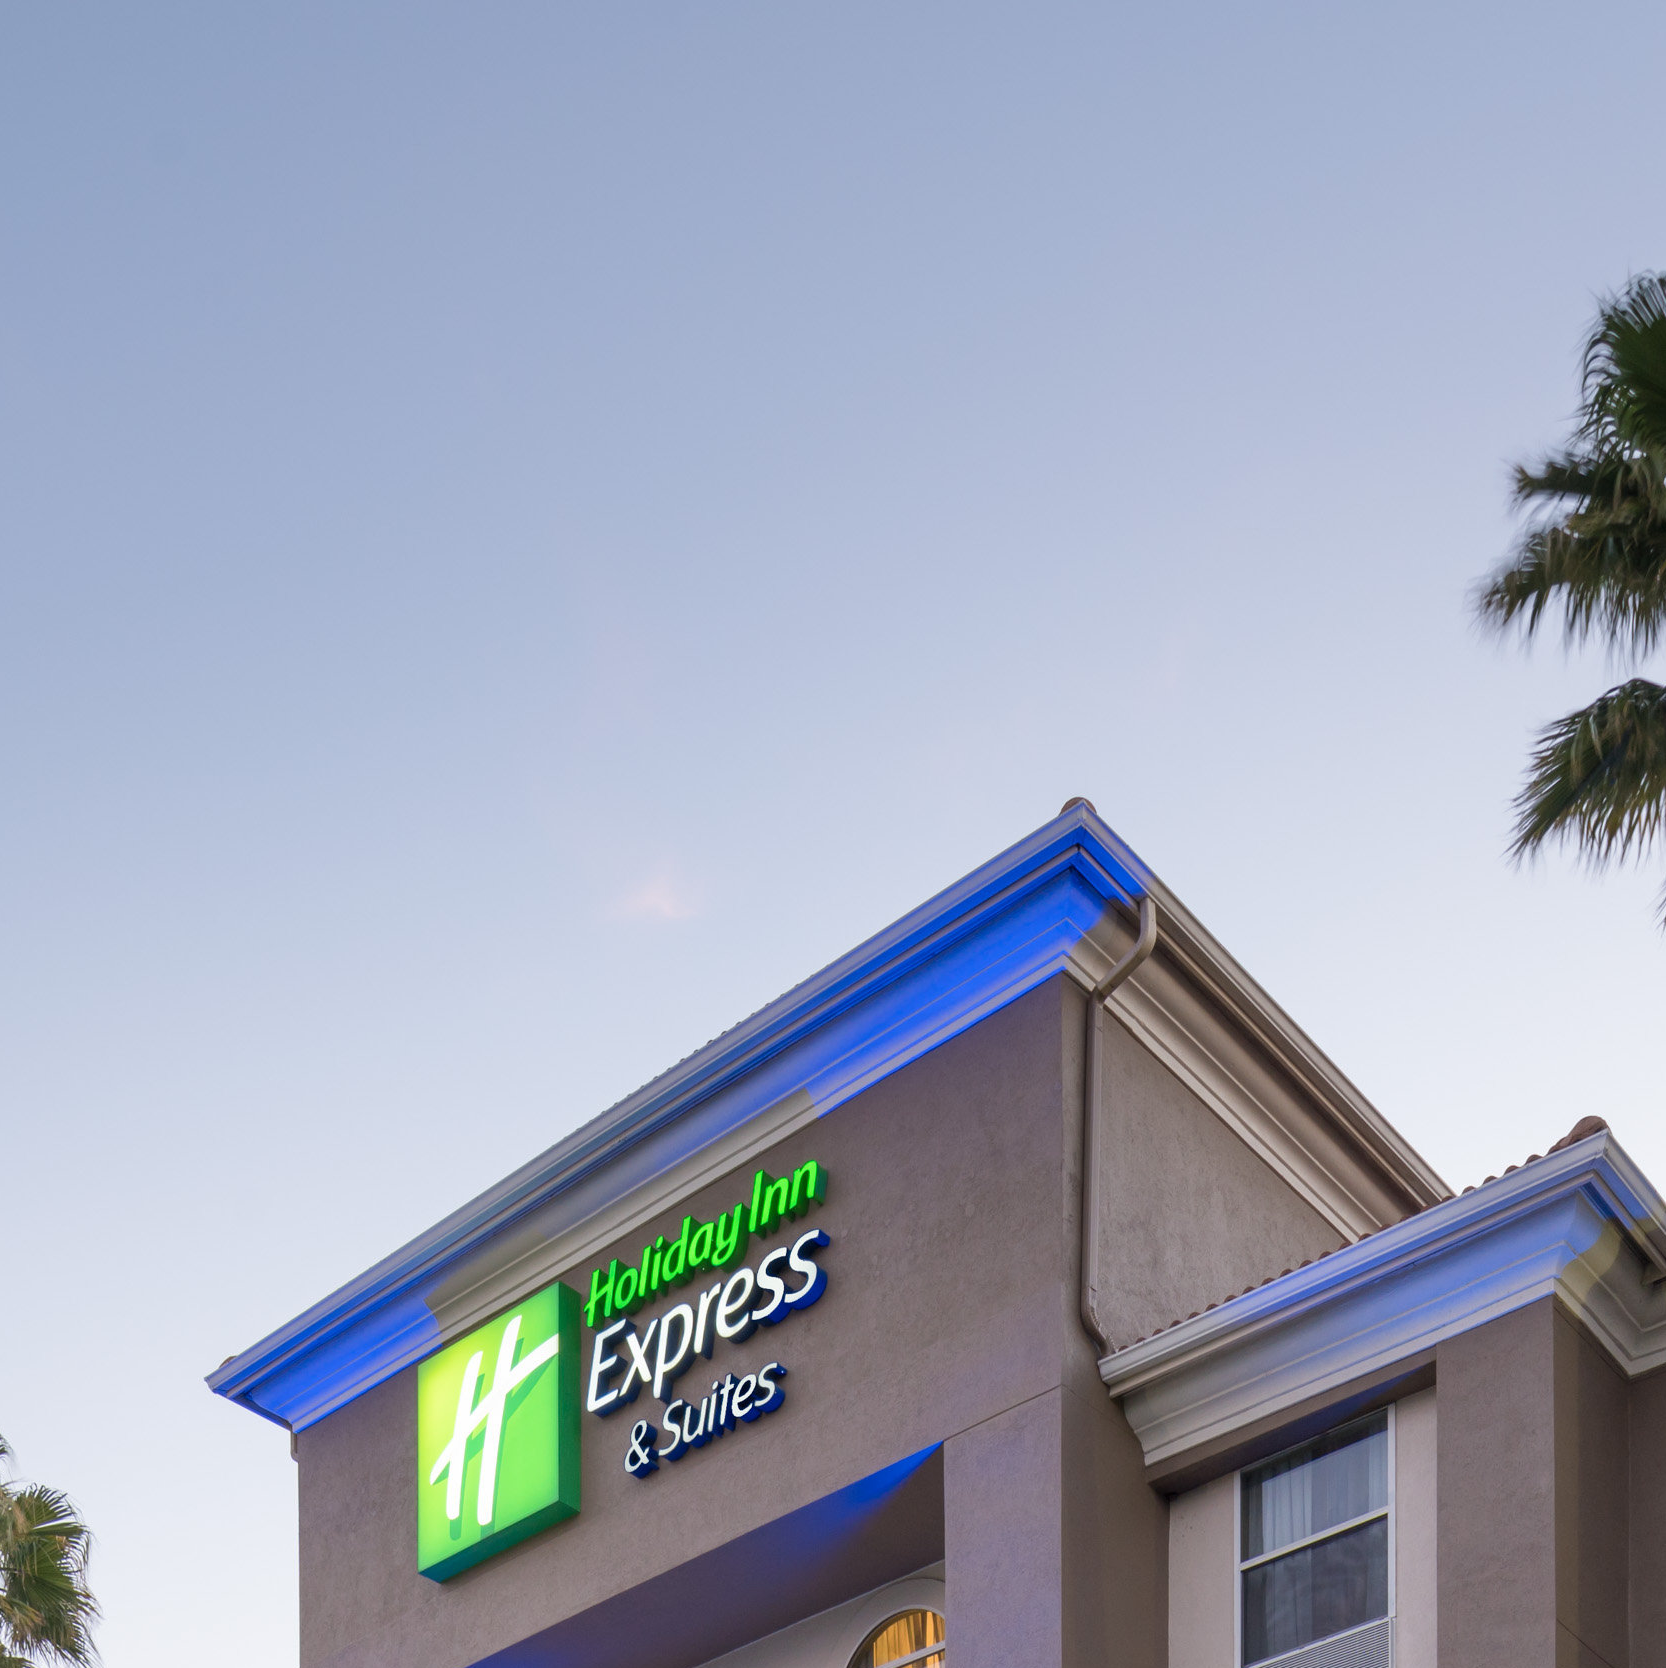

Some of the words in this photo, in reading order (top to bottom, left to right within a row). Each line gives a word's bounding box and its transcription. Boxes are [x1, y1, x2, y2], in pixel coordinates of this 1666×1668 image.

[583, 1202, 743, 1328] Holiday
[749, 1160, 819, 1233] Inn
[586, 1228, 821, 1413] Express
[623, 1419, 651, 1473] &
[658, 1361, 780, 1457] Suites
